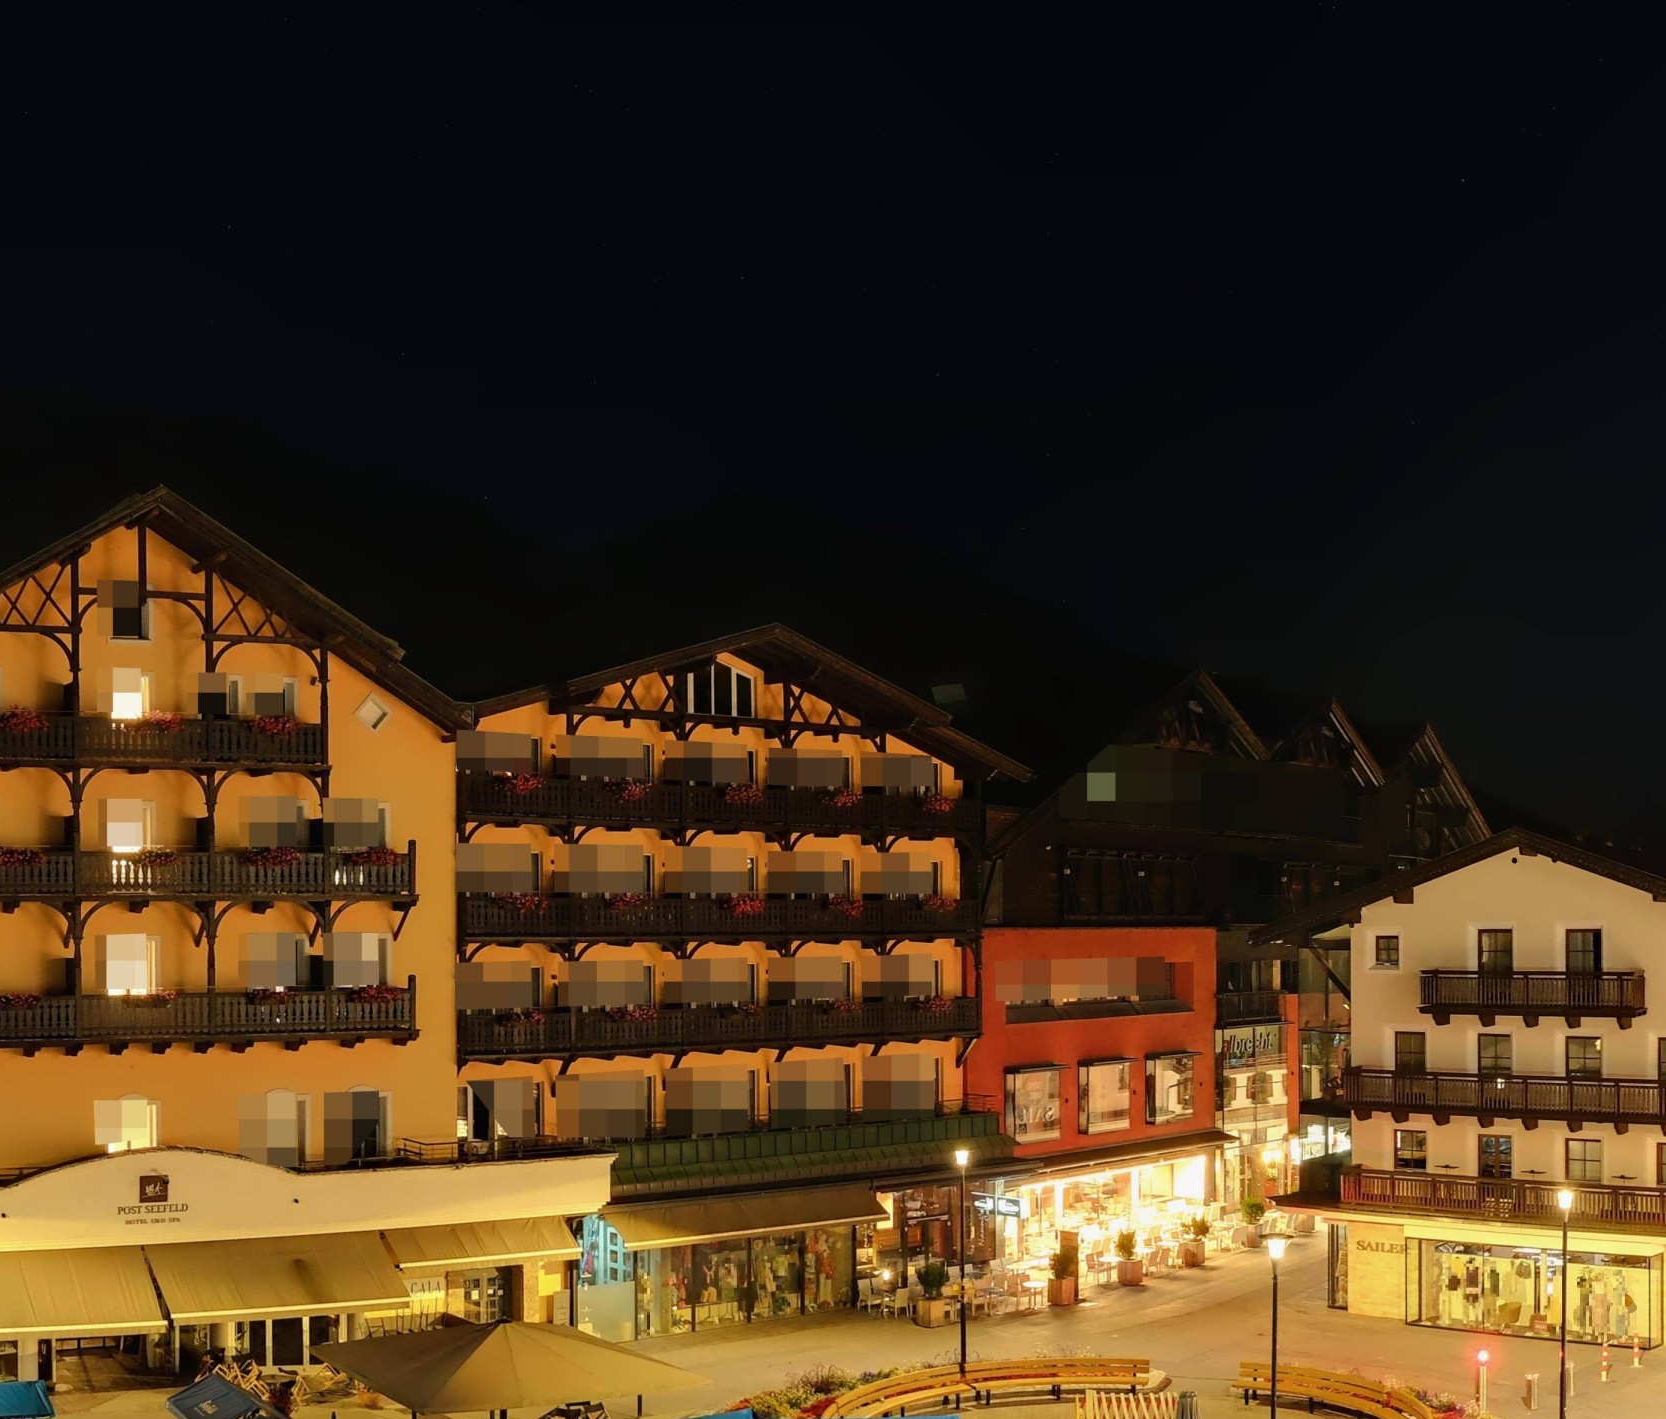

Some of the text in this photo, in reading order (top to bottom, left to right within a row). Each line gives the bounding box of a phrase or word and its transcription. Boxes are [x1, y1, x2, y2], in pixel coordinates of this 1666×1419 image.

[117, 1203, 188, 1215] POST SEEFELD
[410, 1281, 442, 1295] GALA
